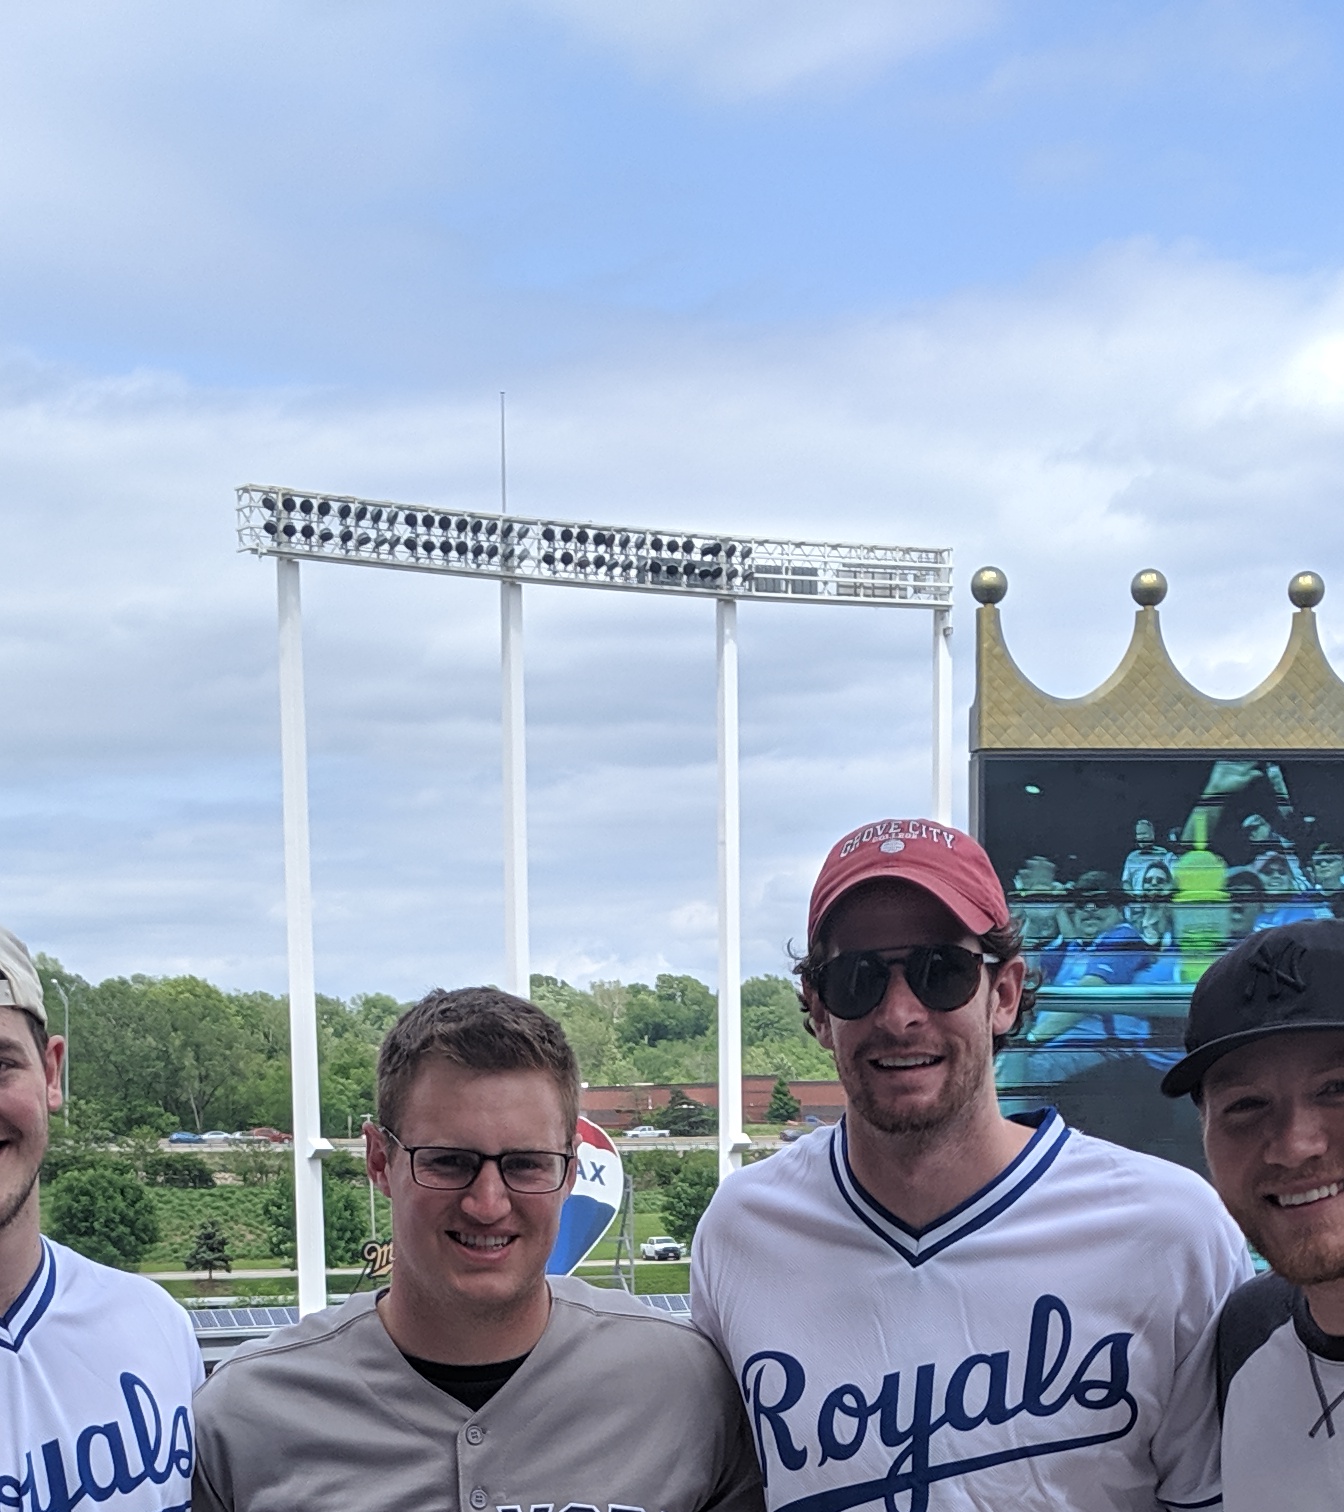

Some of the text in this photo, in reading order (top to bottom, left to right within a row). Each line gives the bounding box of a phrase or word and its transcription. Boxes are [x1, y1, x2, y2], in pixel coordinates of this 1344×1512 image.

[840, 820, 955, 858] GROVE CITY
[577, 1161, 607, 1187] AX
